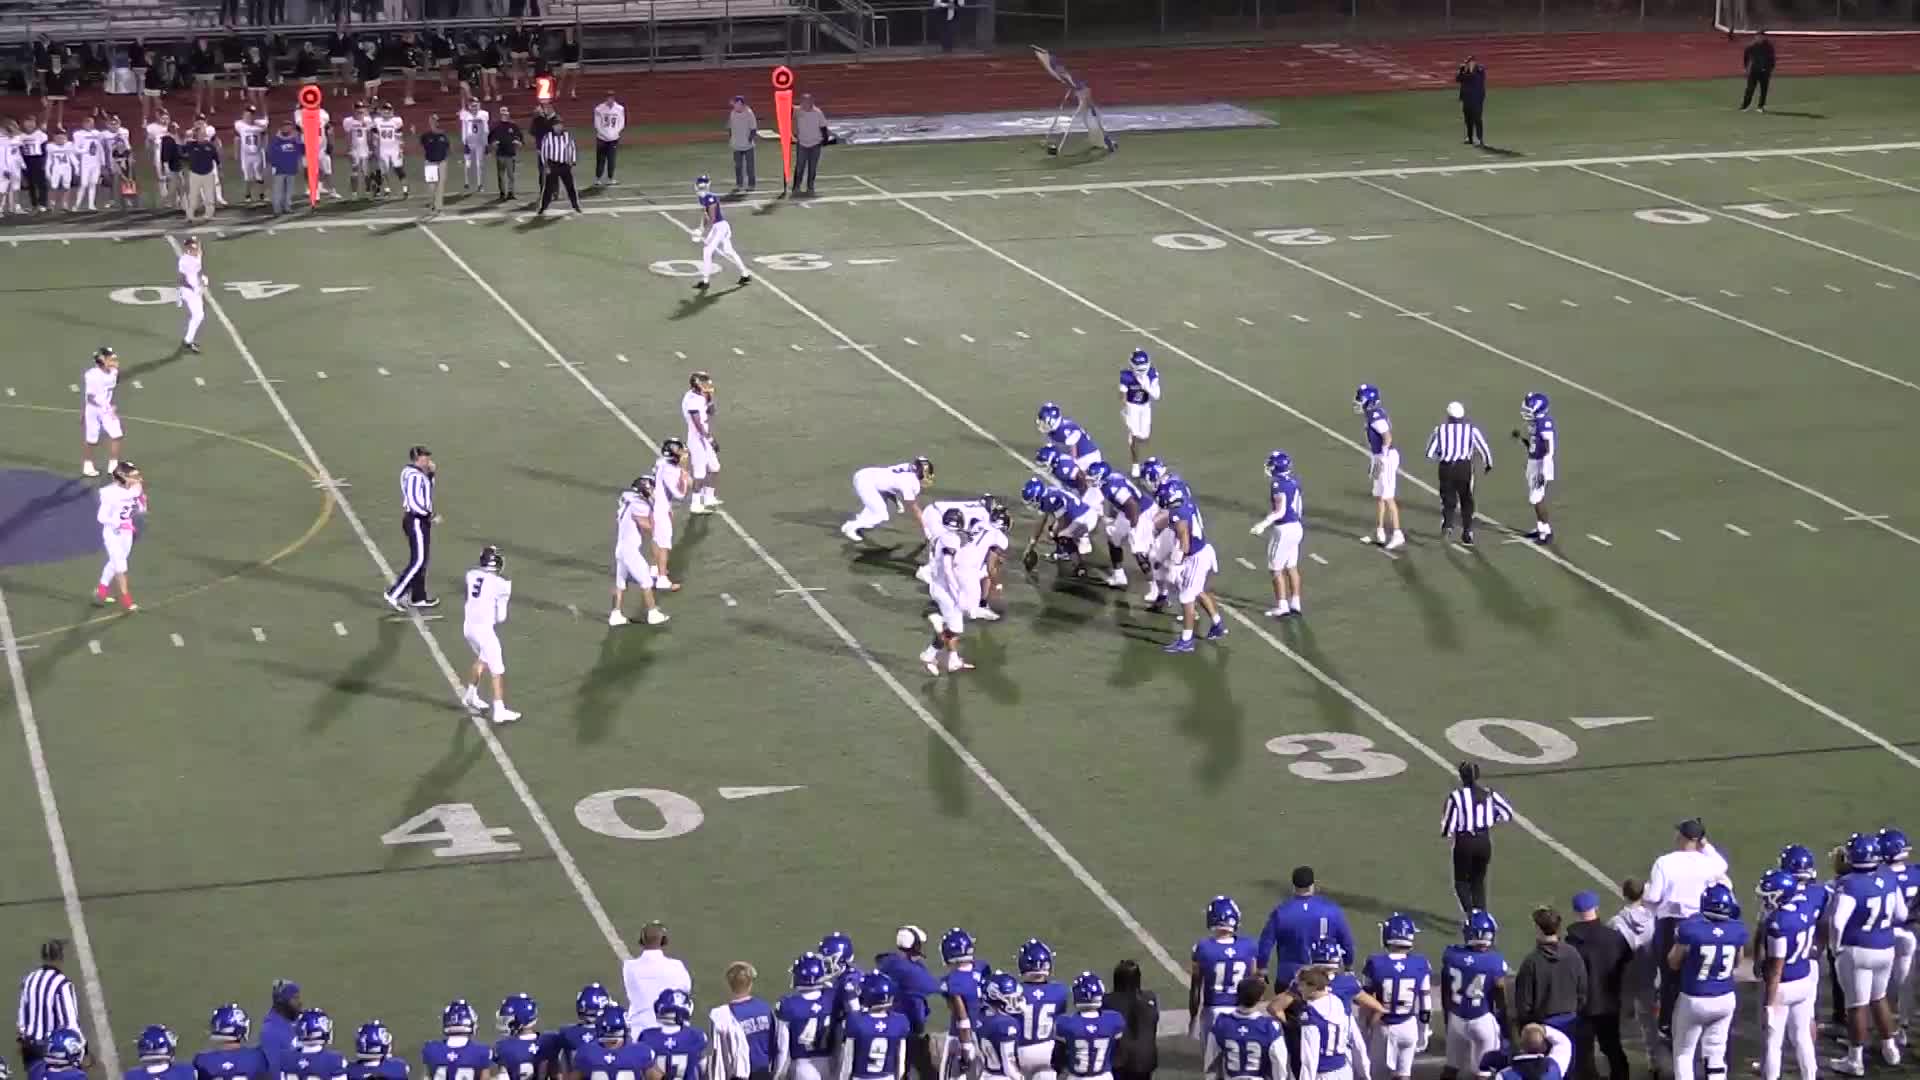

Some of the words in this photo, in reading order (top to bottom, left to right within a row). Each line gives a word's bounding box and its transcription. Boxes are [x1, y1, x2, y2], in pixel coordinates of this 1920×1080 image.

[538, 79, 551, 98] 2
[1697, 945, 1737, 981] 73
[1382, 977, 1416, 1014] 15
[1023, 1003, 1056, 1040] 16
